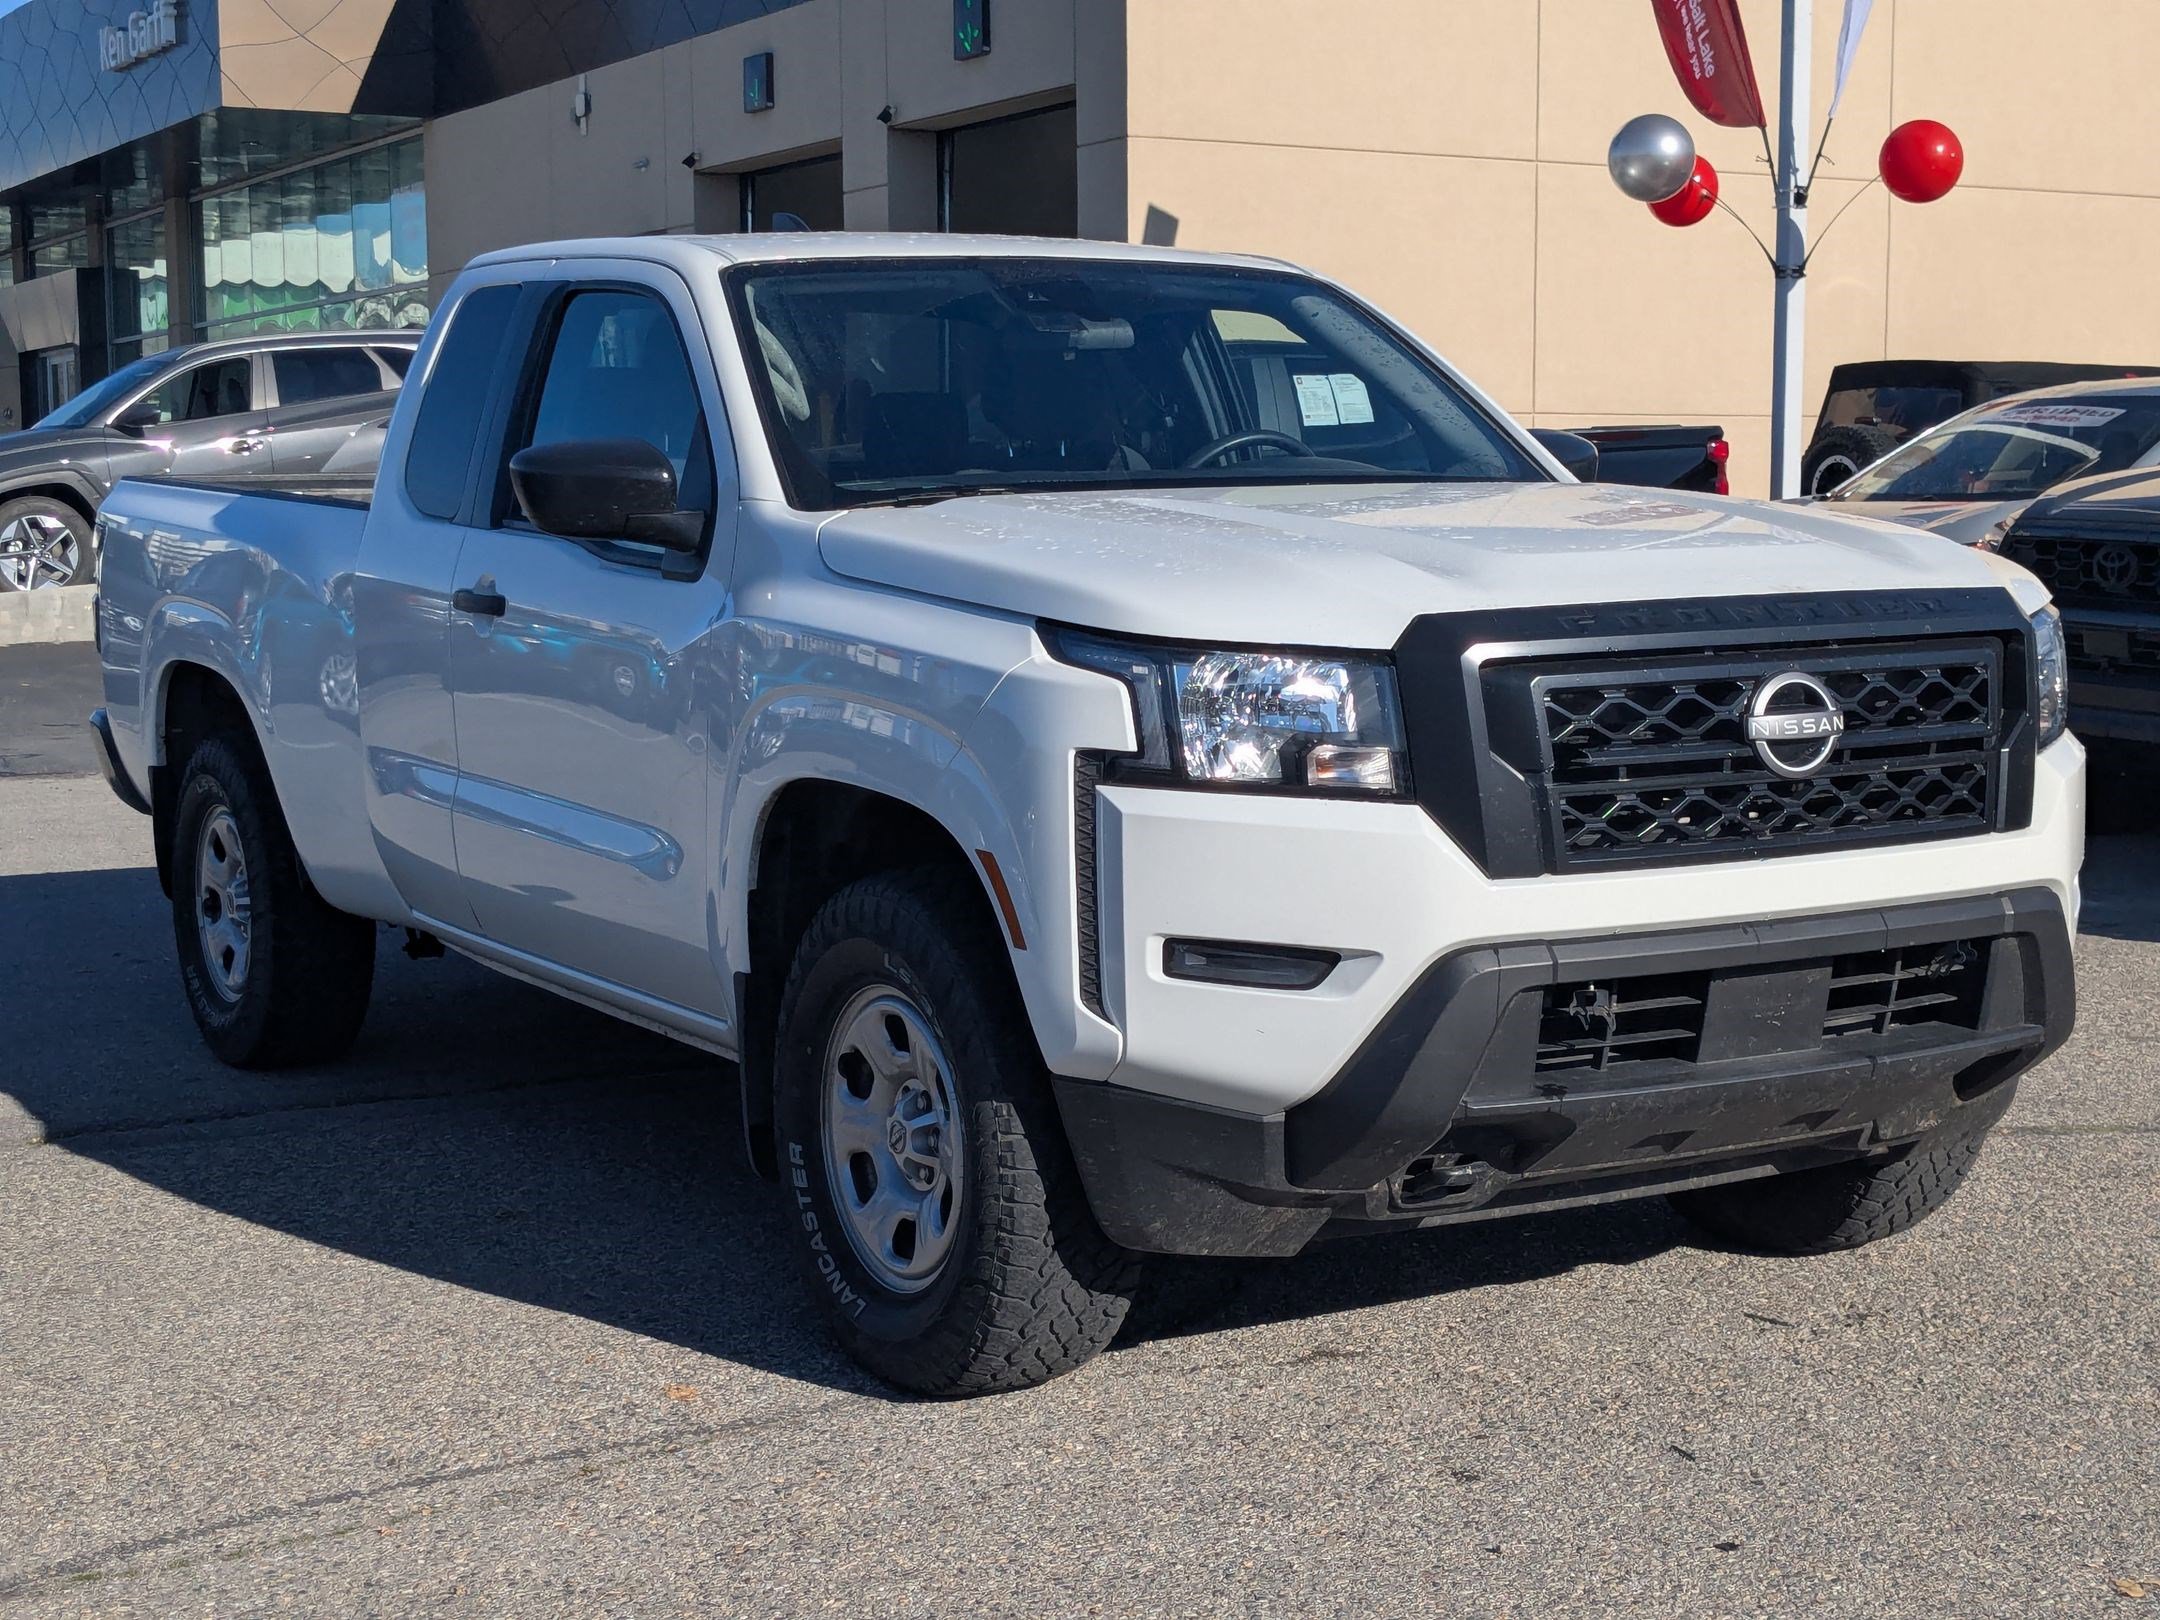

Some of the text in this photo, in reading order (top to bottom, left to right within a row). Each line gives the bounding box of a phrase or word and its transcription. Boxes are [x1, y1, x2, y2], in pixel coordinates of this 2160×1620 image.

[99, 26, 134, 72] Ken
[1690, 54, 1701, 80] you
[1697, 29, 1715, 78] Lake
[1752, 715, 1844, 736] NISSAN
[788, 1141, 867, 1319] LANCASTER
